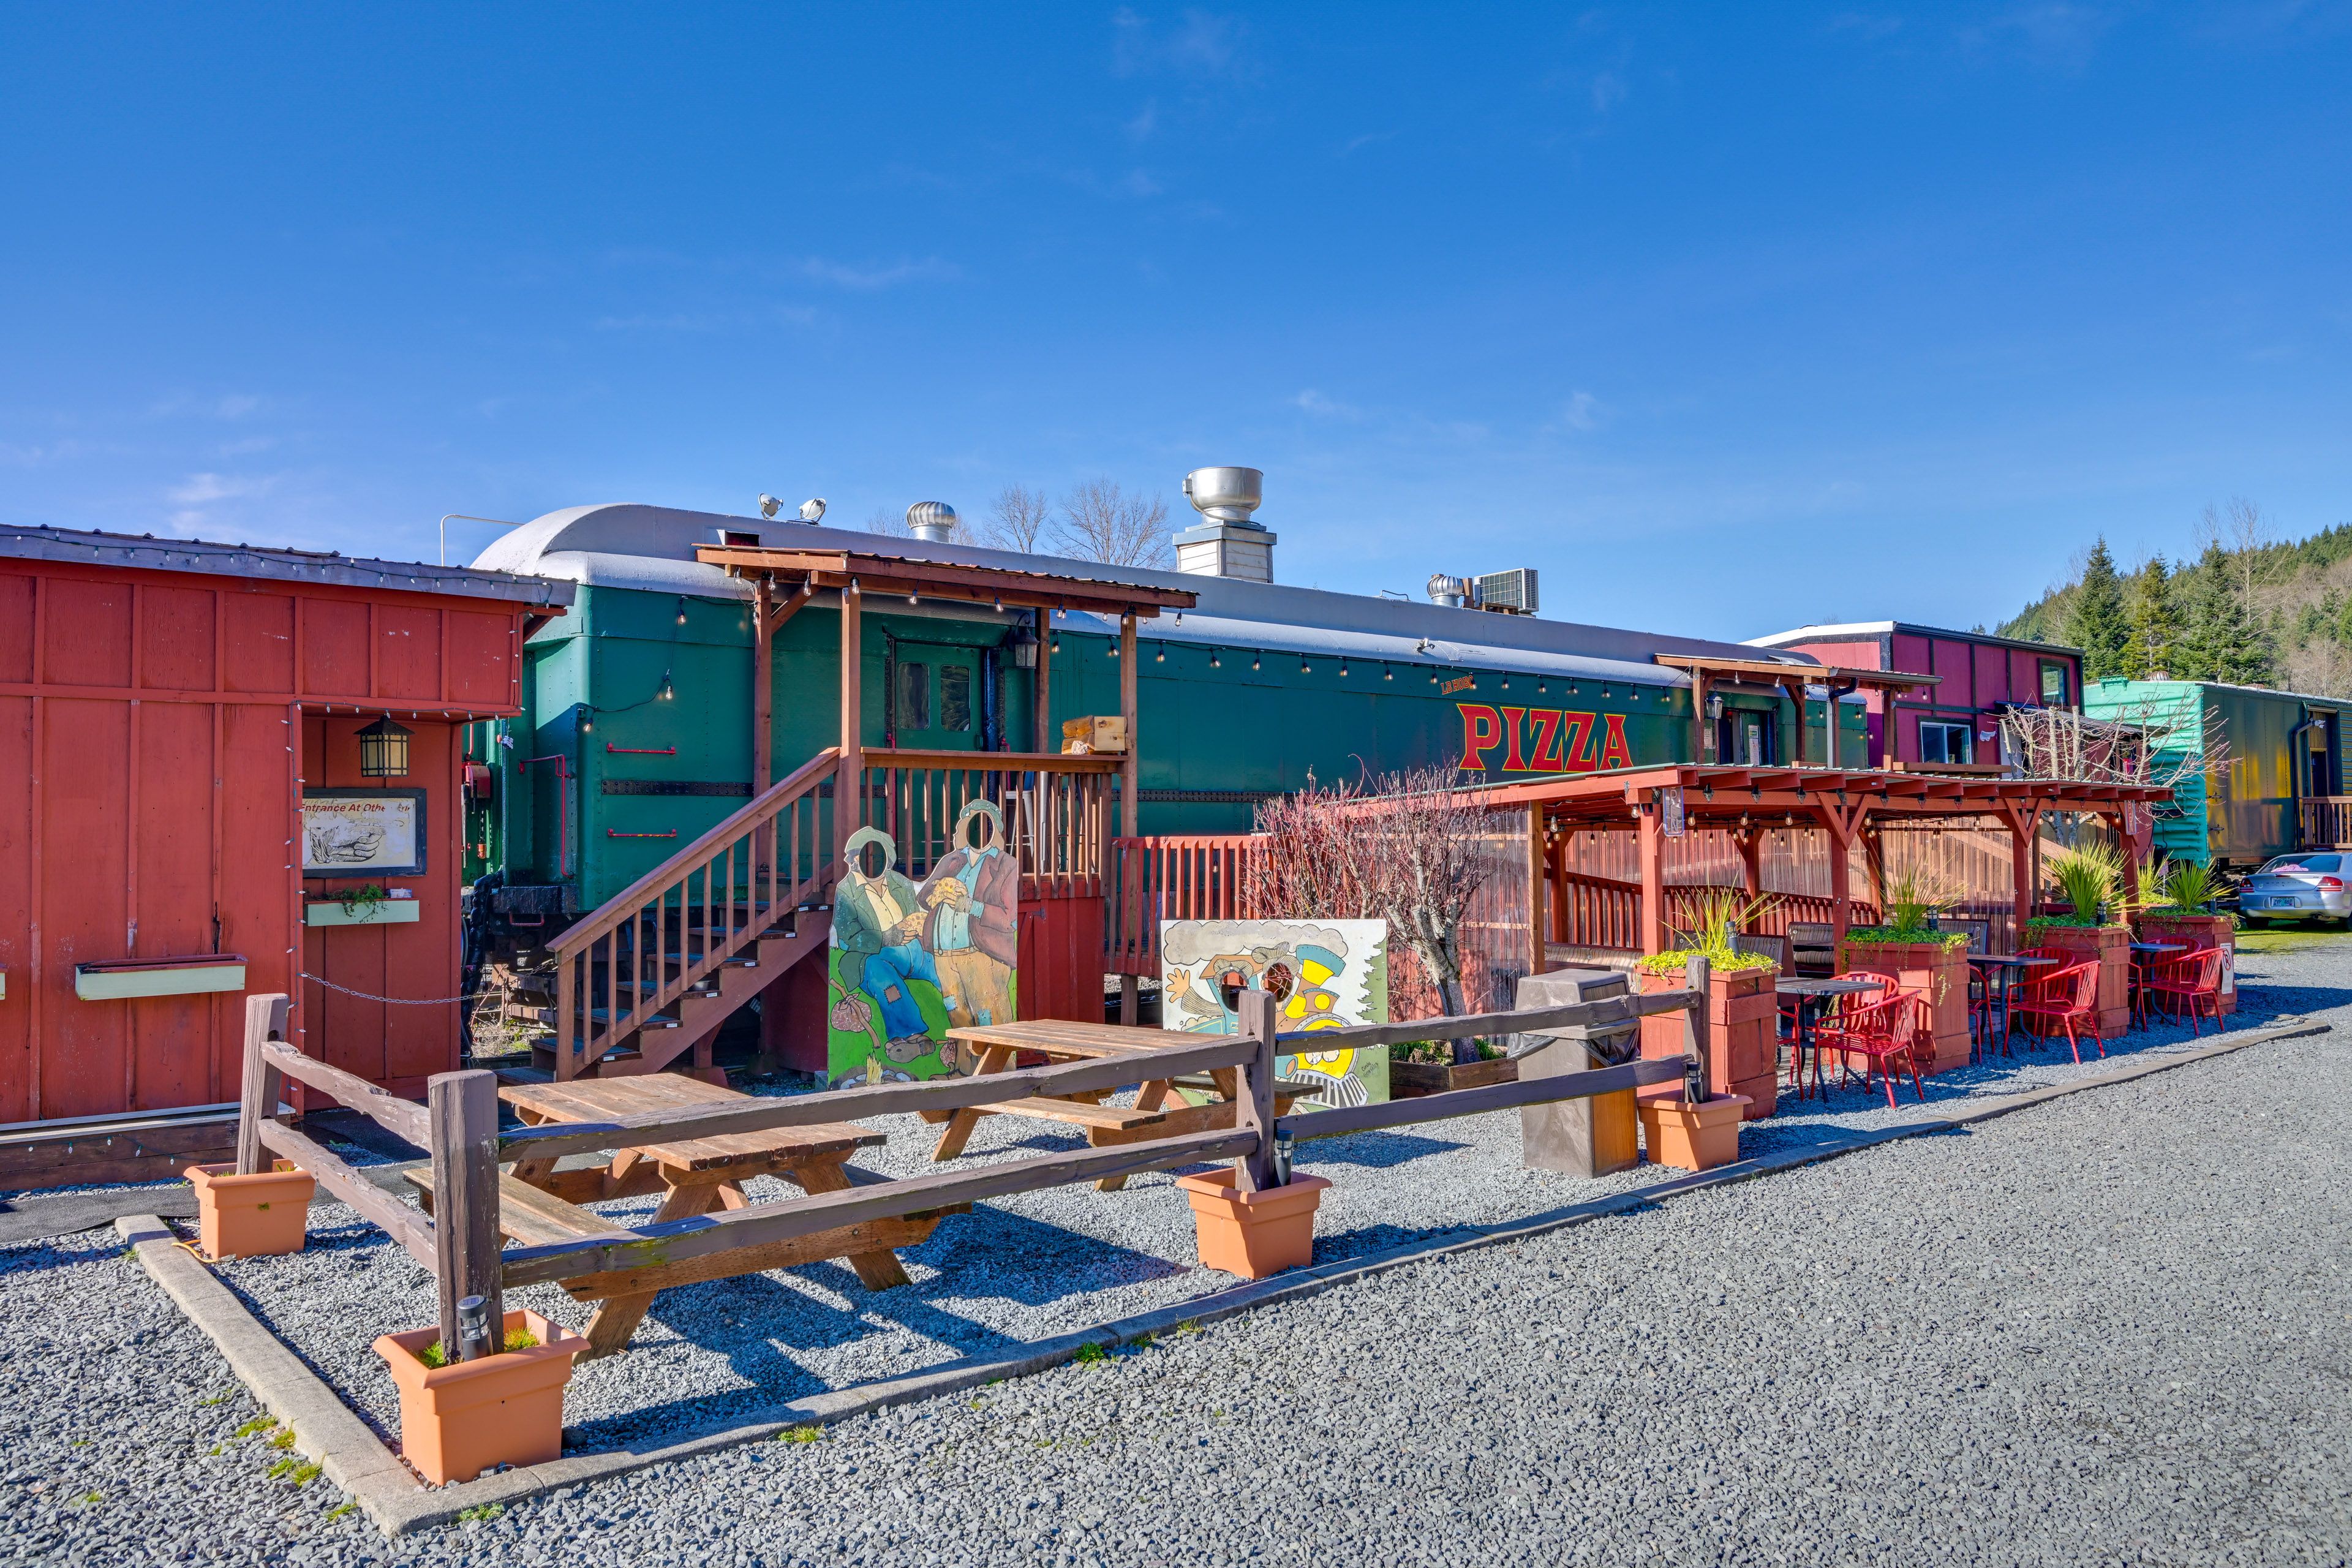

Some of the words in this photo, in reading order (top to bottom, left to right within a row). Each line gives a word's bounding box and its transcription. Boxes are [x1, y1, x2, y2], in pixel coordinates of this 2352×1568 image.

[1457, 704, 1634, 772] PIZZA
[363, 804, 388, 812] Othe
[1670, 786, 1679, 832] PEN
